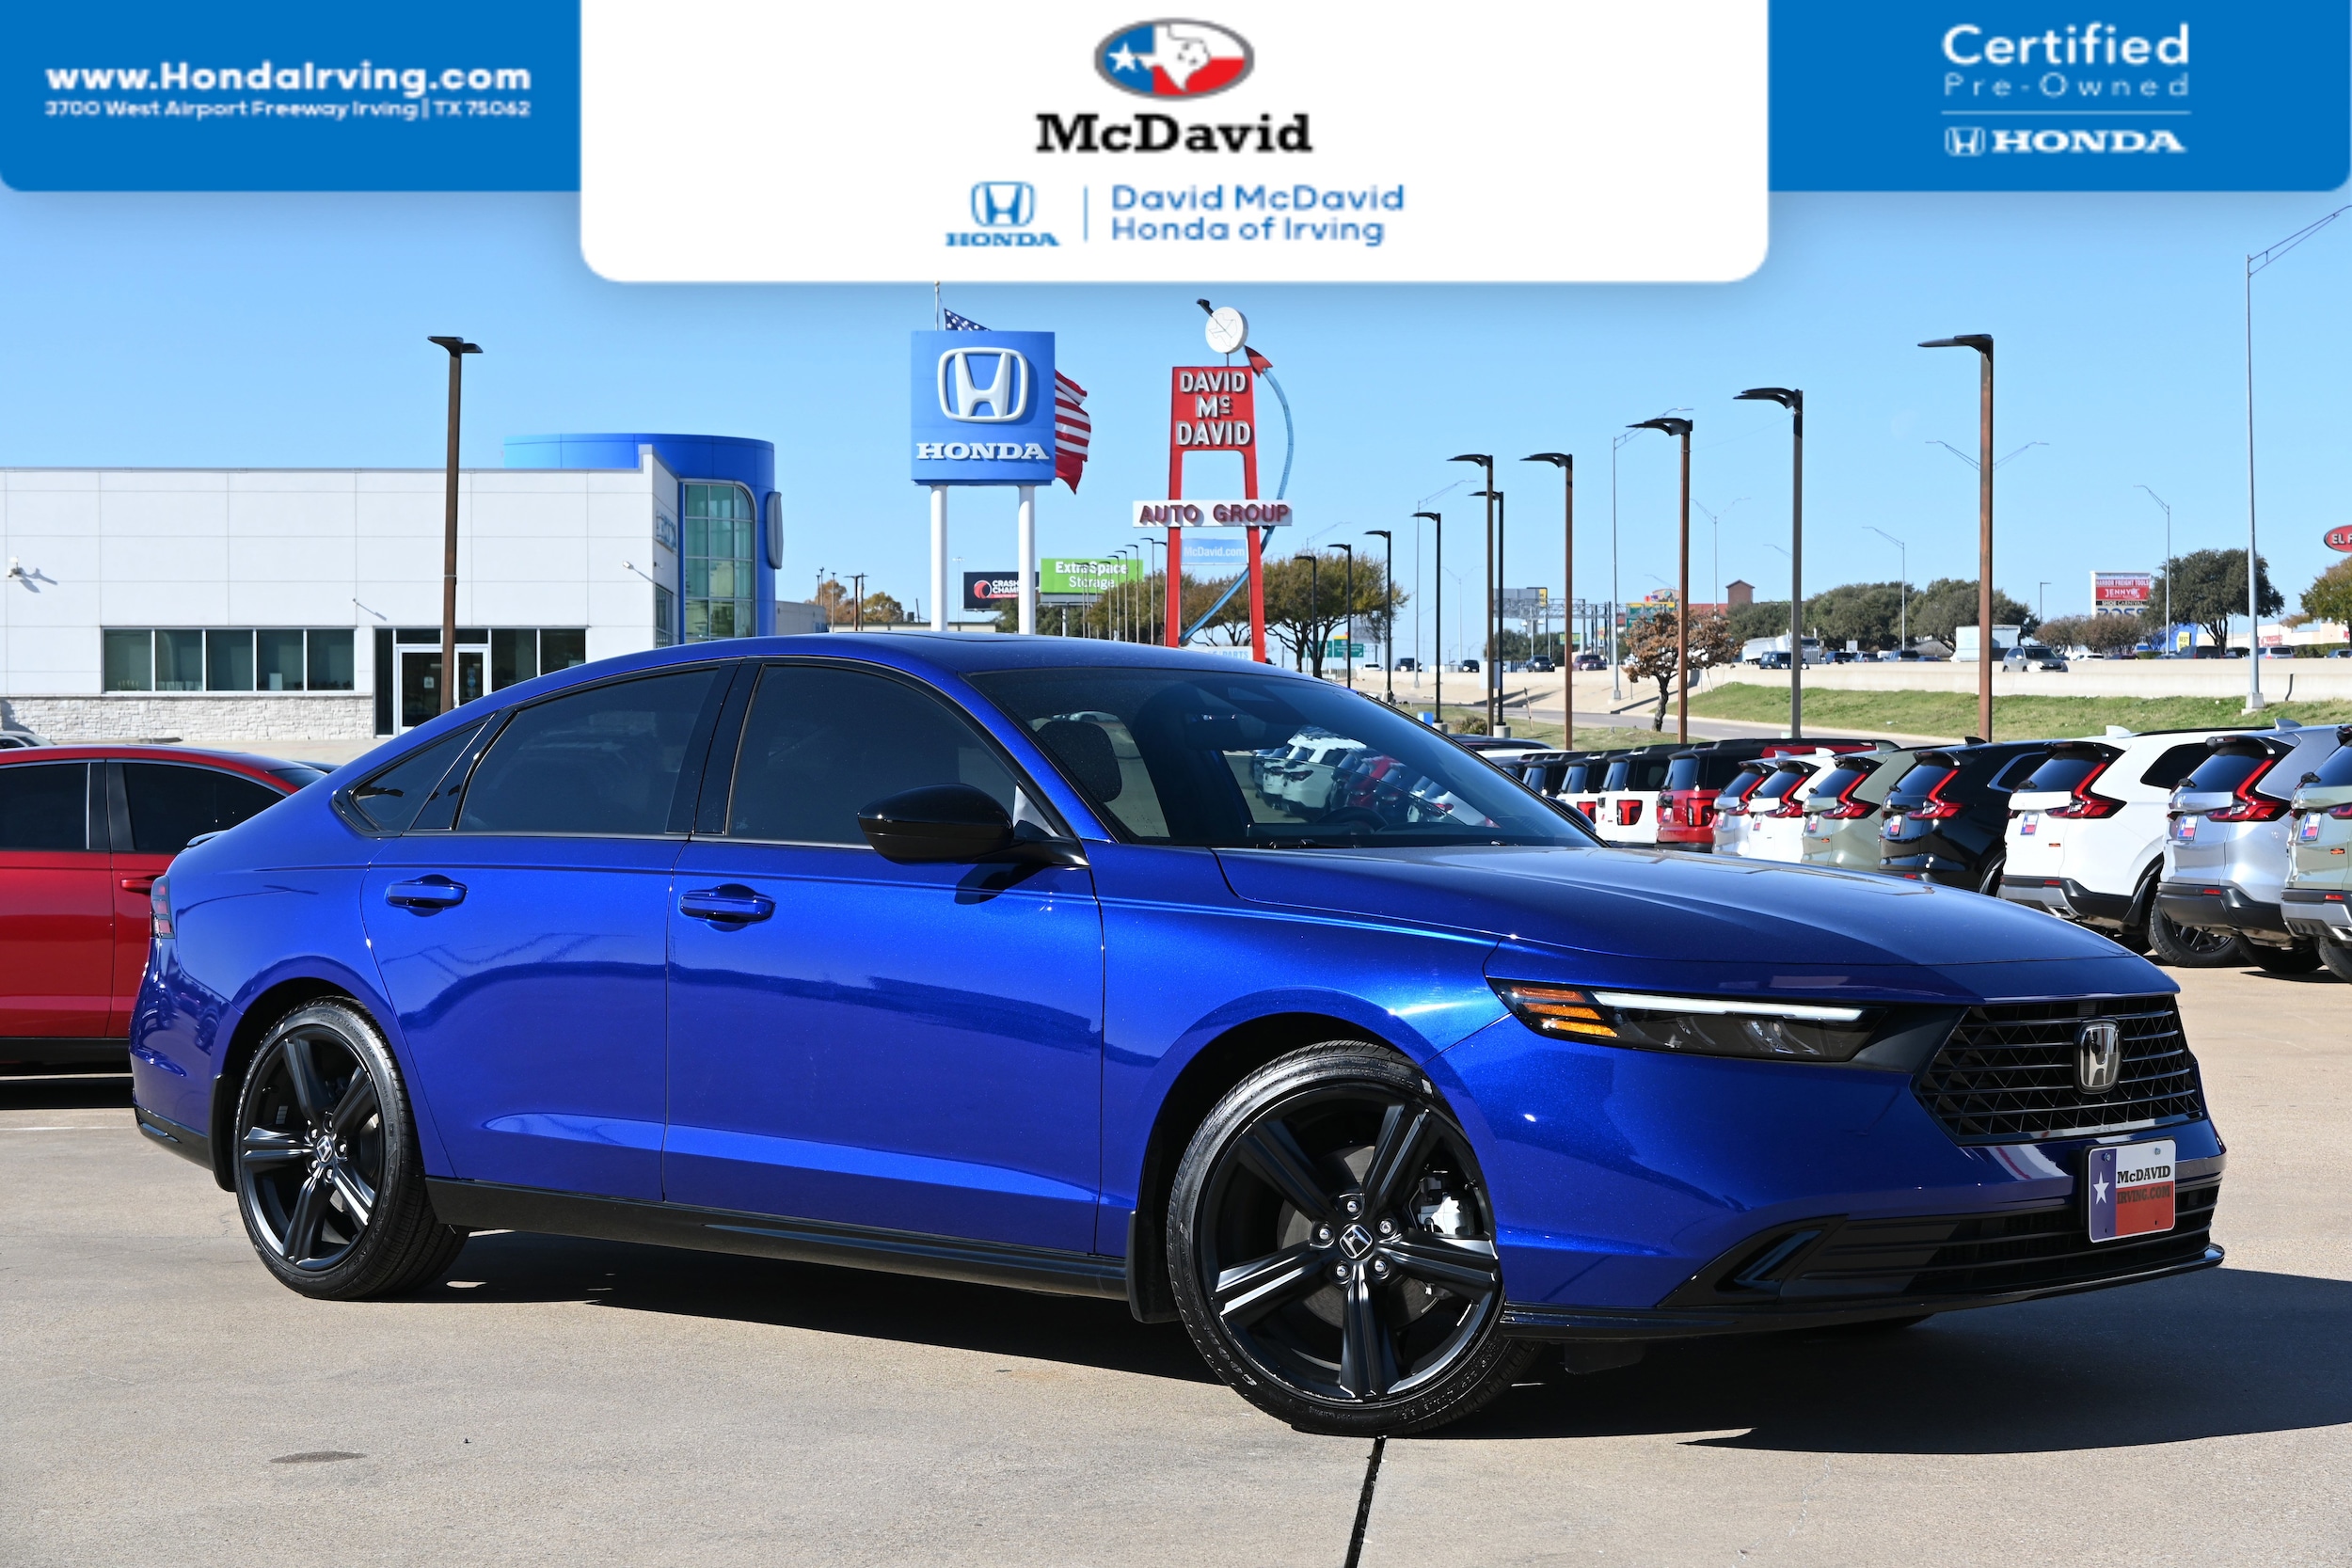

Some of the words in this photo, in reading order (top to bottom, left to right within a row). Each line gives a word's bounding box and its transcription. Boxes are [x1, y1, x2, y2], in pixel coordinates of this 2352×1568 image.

[1180, 371, 1247, 393] DAVID
[1176, 420, 1251, 446] DAVID
[916, 442, 1050, 460] HONDA
[1139, 504, 1200, 524] AUTO
[1213, 503, 1290, 523] GROUP
[2331, 533, 2344, 545] EL
[1184, 546, 1246, 559] McDavid.com
[1069, 576, 1115, 590] Storage
[2117, 1165, 2171, 1184] McDAVID
[2117, 1185, 2170, 1204] IRVING.COM
